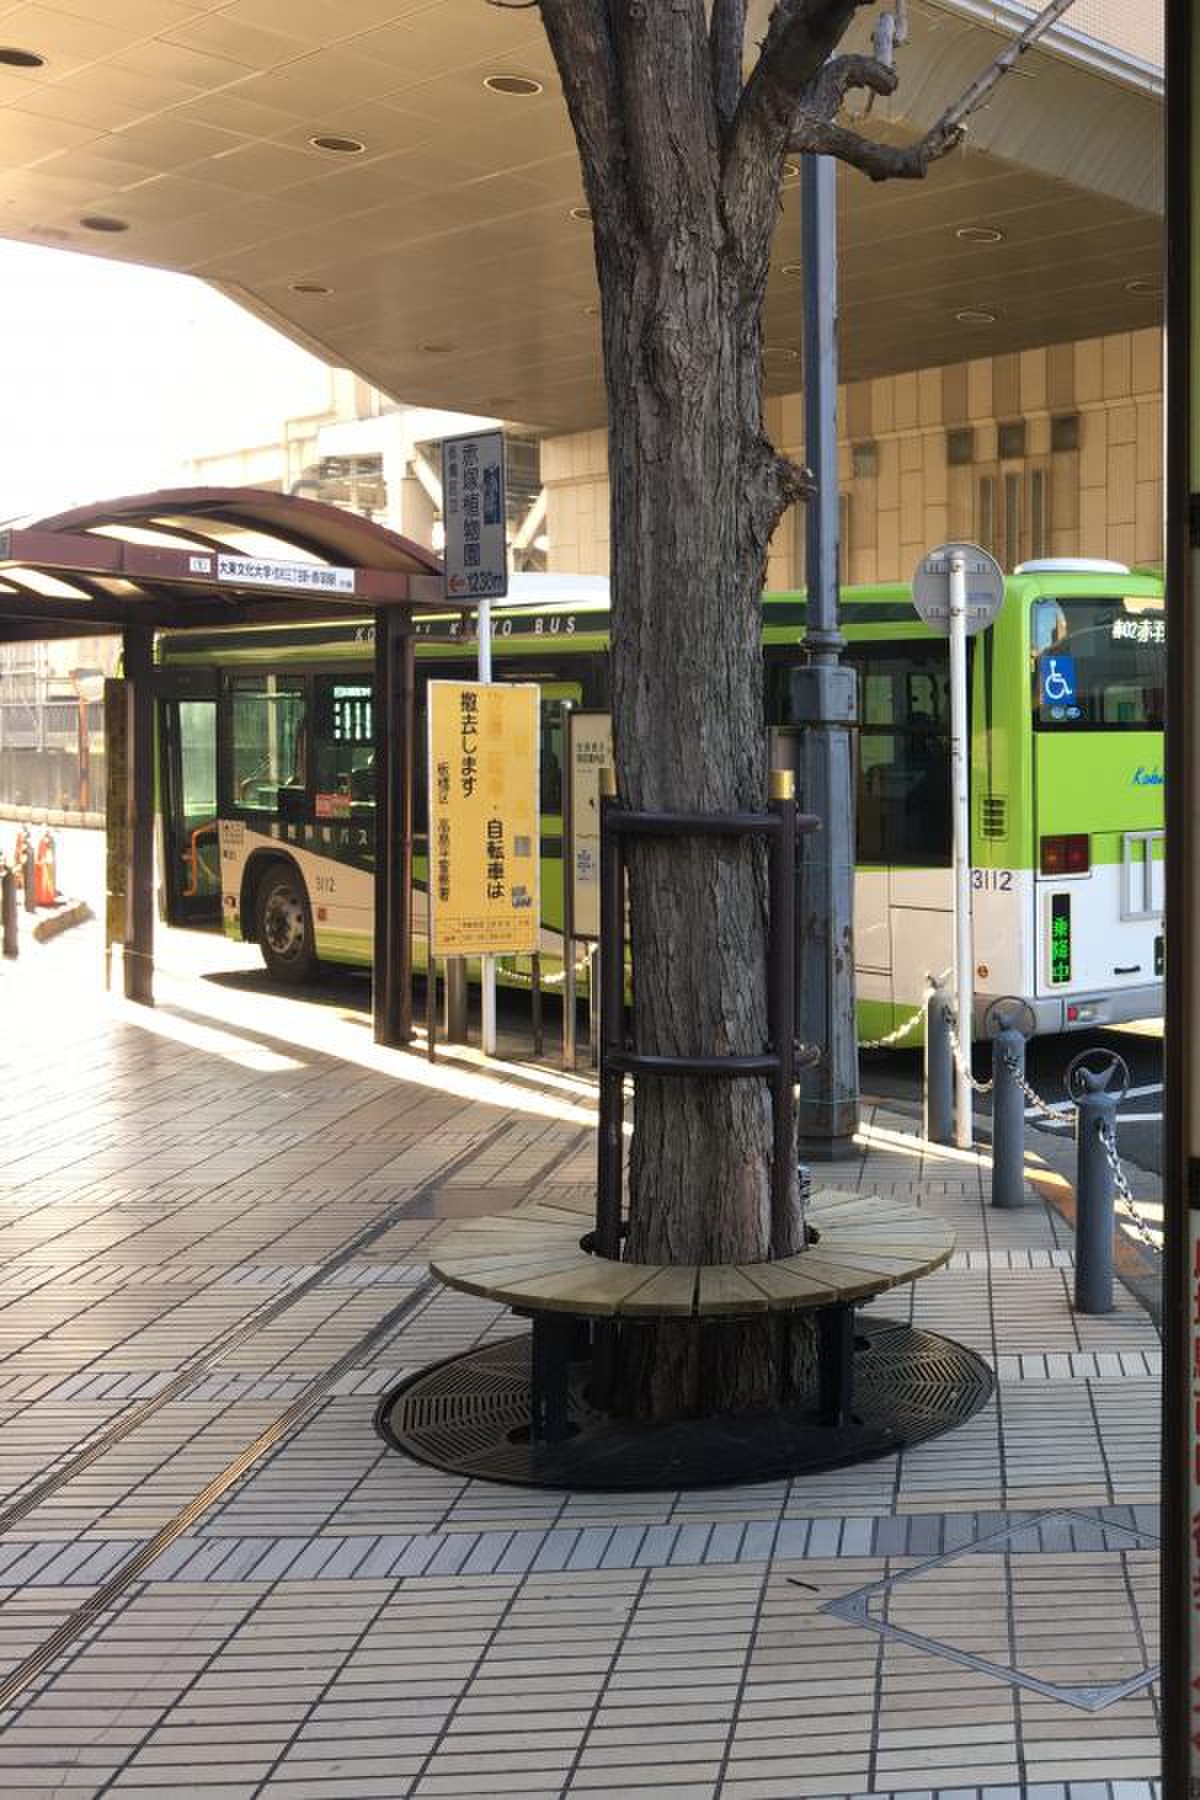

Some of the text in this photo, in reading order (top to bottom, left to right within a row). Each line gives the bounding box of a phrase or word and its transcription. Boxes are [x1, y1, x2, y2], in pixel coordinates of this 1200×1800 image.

[532, 616, 575, 635] BUS
[460, 690, 479, 799] 撤去します
[486, 818, 505, 900] 自転車は
[973, 868, 1013, 892] 3112
